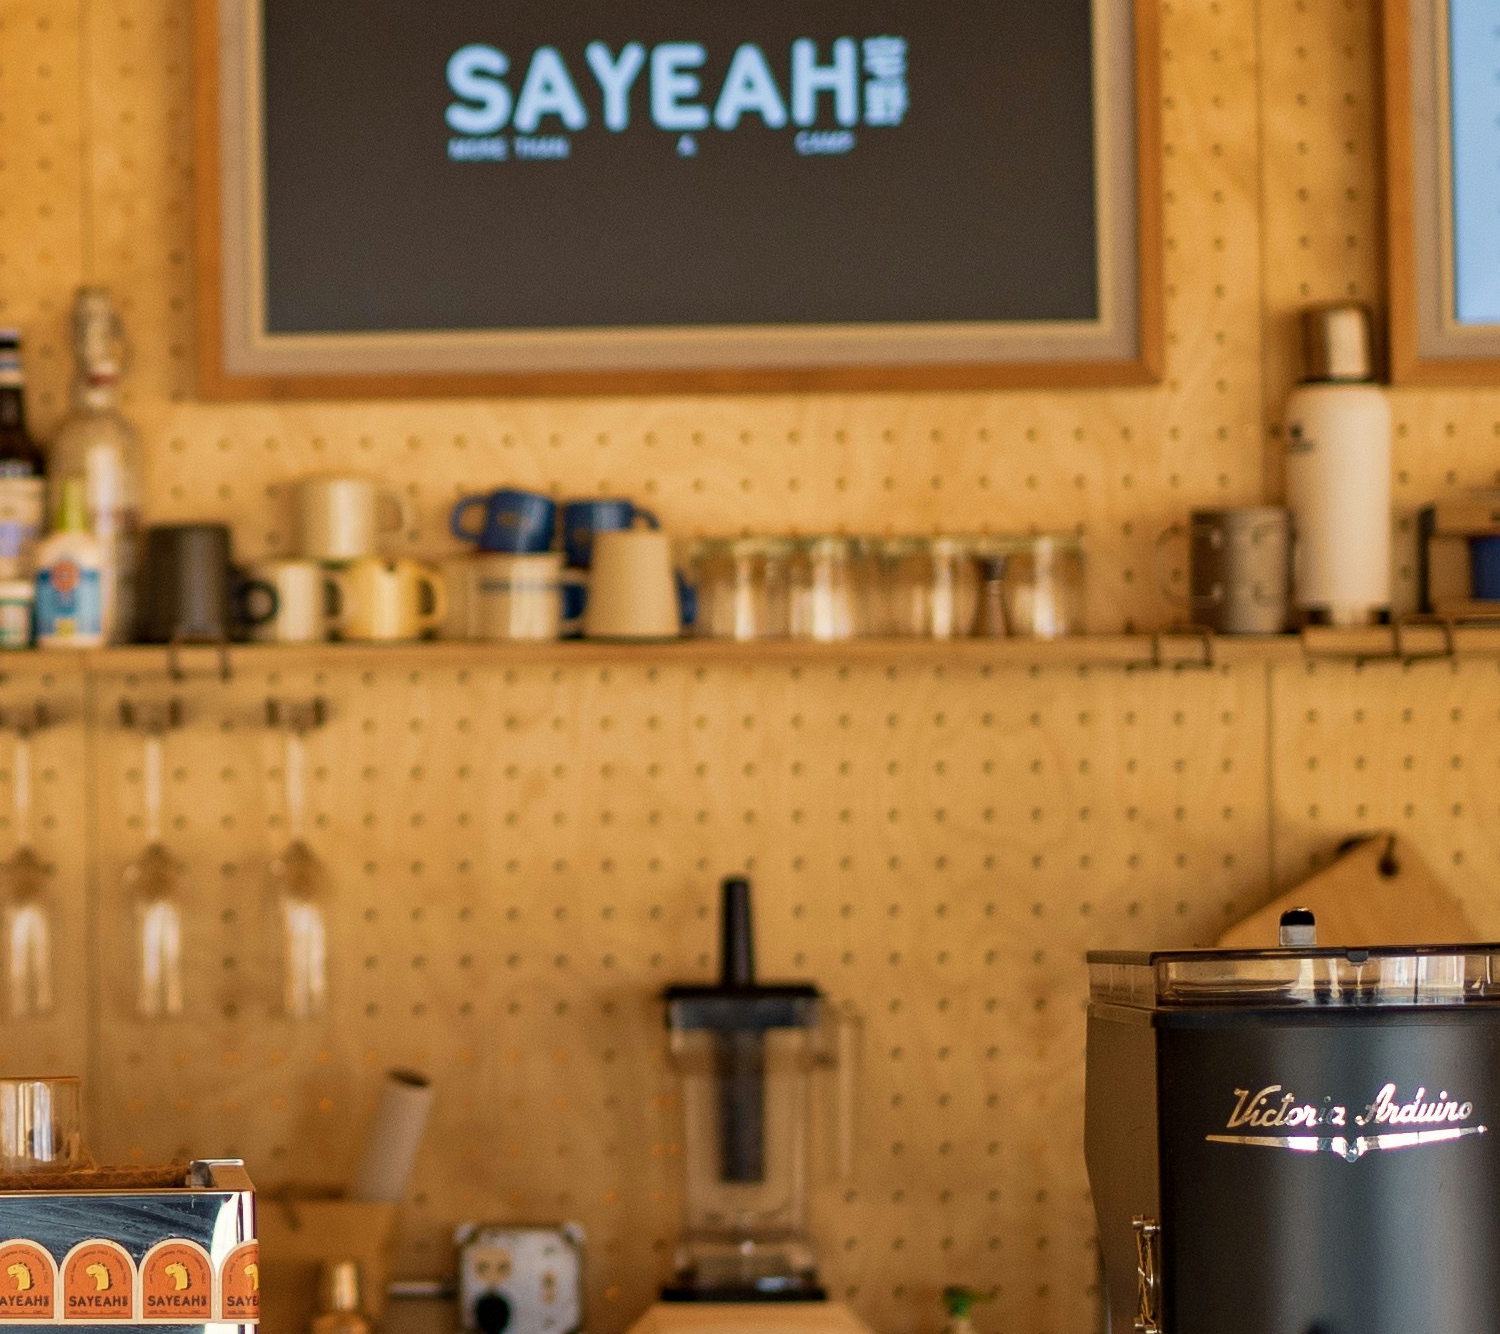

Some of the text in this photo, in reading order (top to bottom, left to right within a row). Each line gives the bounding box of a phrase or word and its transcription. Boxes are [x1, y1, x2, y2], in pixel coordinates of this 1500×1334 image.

[445, 38, 860, 135] SAYEAH
[1227, 1083, 1473, 1128] Victoria Arduino
[69, 1295, 121, 1307] SAYEAH
[147, 1295, 199, 1307] SAYEAH
